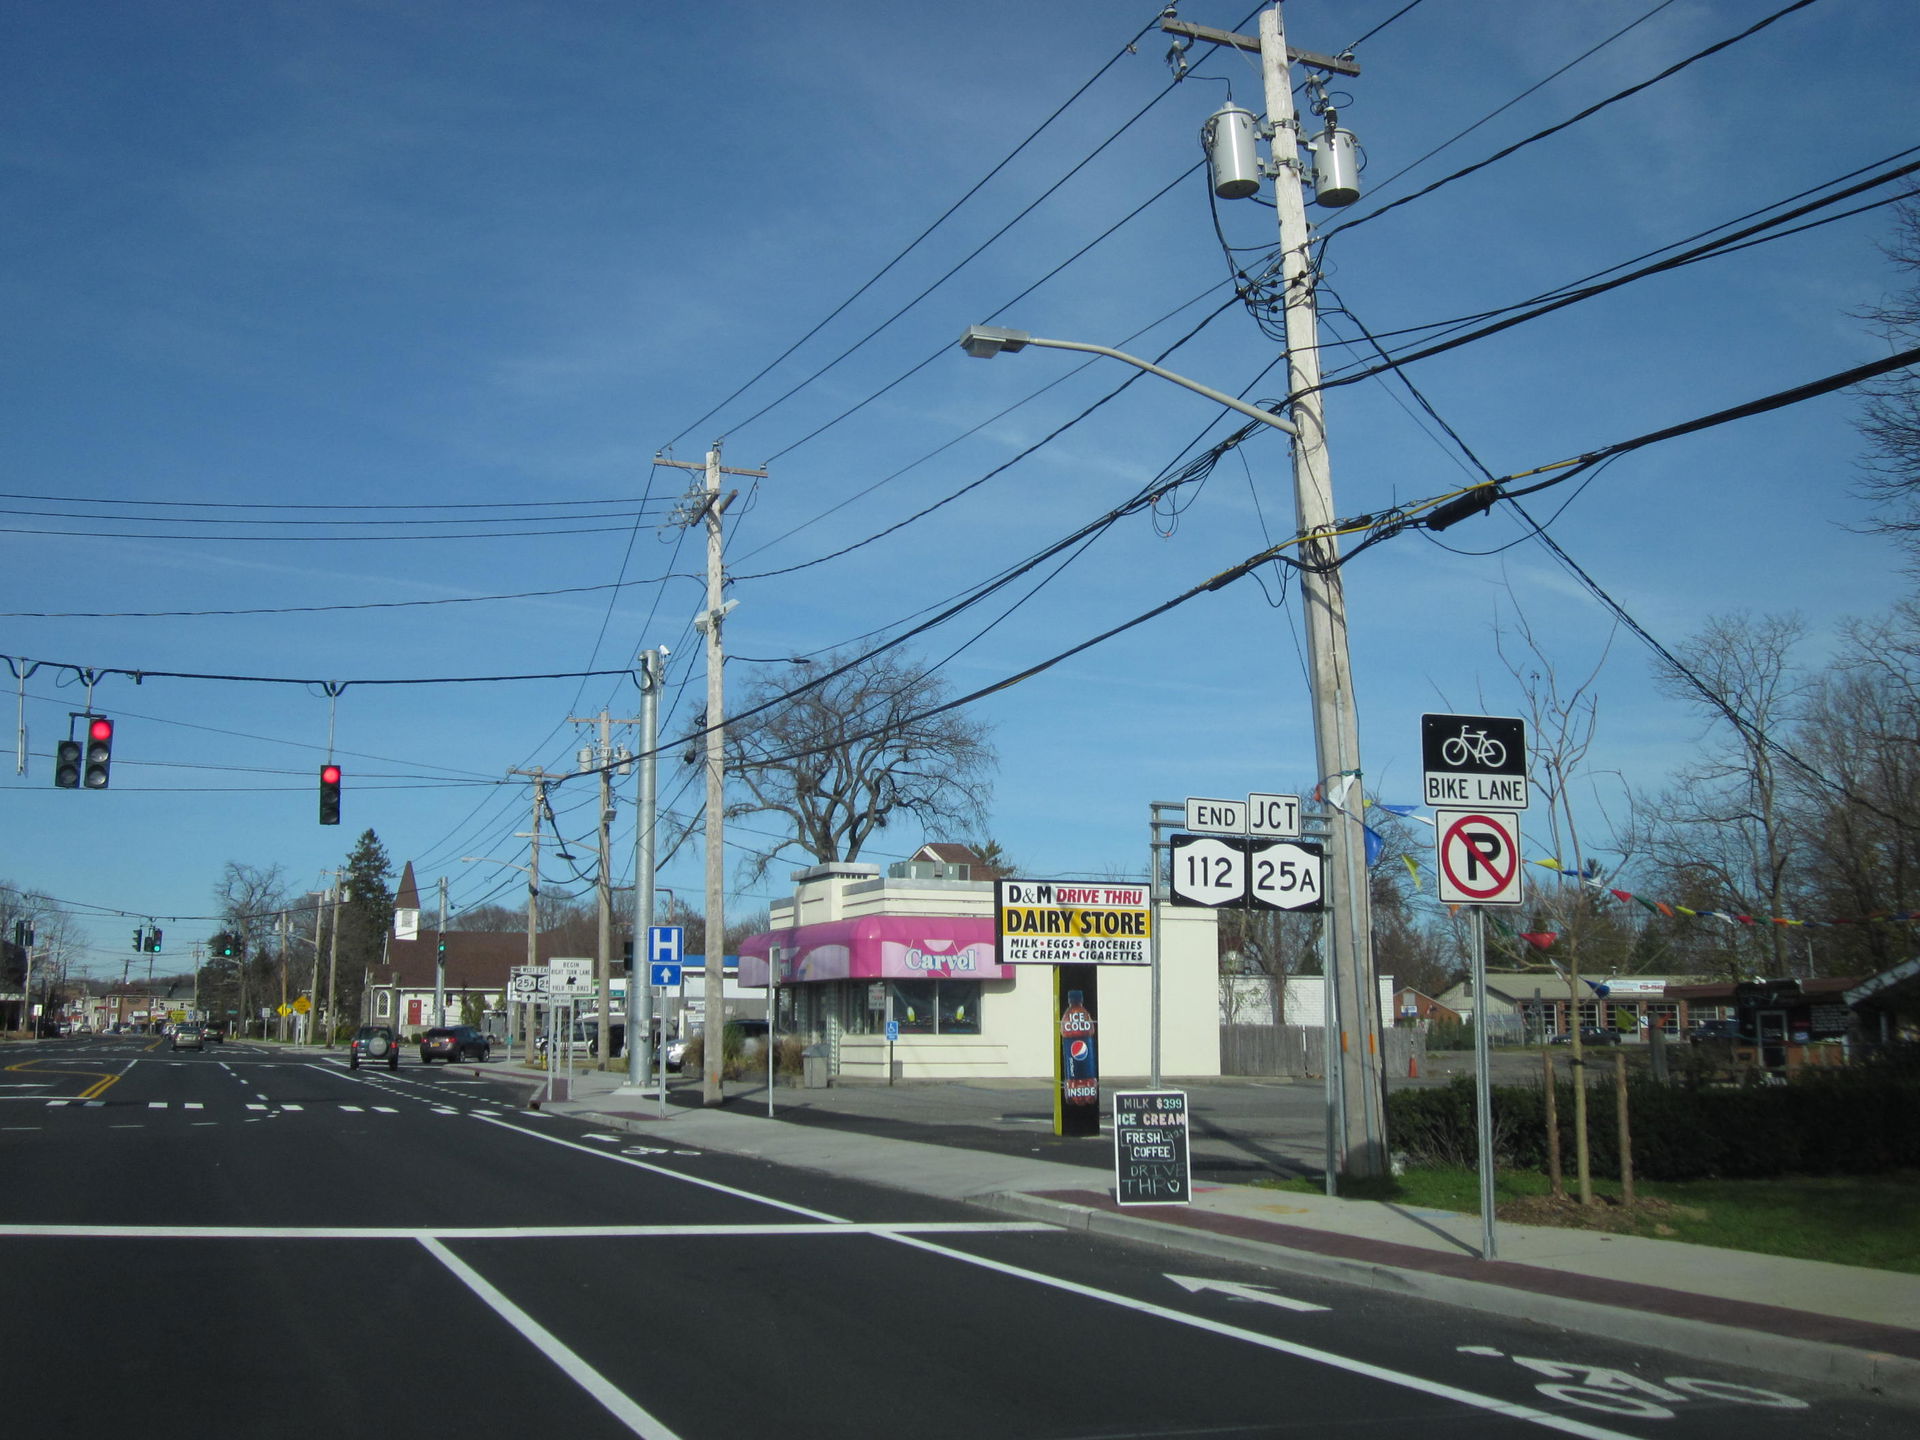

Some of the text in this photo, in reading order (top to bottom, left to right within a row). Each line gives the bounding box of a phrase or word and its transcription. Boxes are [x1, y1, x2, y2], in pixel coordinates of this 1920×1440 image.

[1429, 777, 1523, 801] BIKE LANE
[1198, 805, 1236, 827] END
[1253, 801, 1297, 830] JCT
[1187, 855, 1233, 888] 112
[1257, 860, 1316, 893] 25A
[1008, 885, 1143, 905] D&M DRIVE THRU
[1007, 909, 1146, 935] DAIRY STORE
[653, 928, 678, 961] H
[1010, 938, 1143, 950] MILK EGGS GROCERIES
[905, 948, 977, 971] Carvel
[1010, 949, 1143, 961] ICE CREAM CIGARETTES
[517, 979, 535, 988] 25A
[1069, 1012, 1085, 1022] ICE
[1064, 1021, 1091, 1031] COLD
[1068, 1087, 1096, 1097] INSIDE
[1124, 1098, 1150, 1109] MILK
[1118, 1113, 1185, 1125] ICE CREAM
[1126, 1132, 1160, 1144] FRESH
[1133, 1146, 1171, 1158] COFFEE
[1130, 1163, 1185, 1177] DRIVE
[1121, 1178, 1180, 1195] THRU
